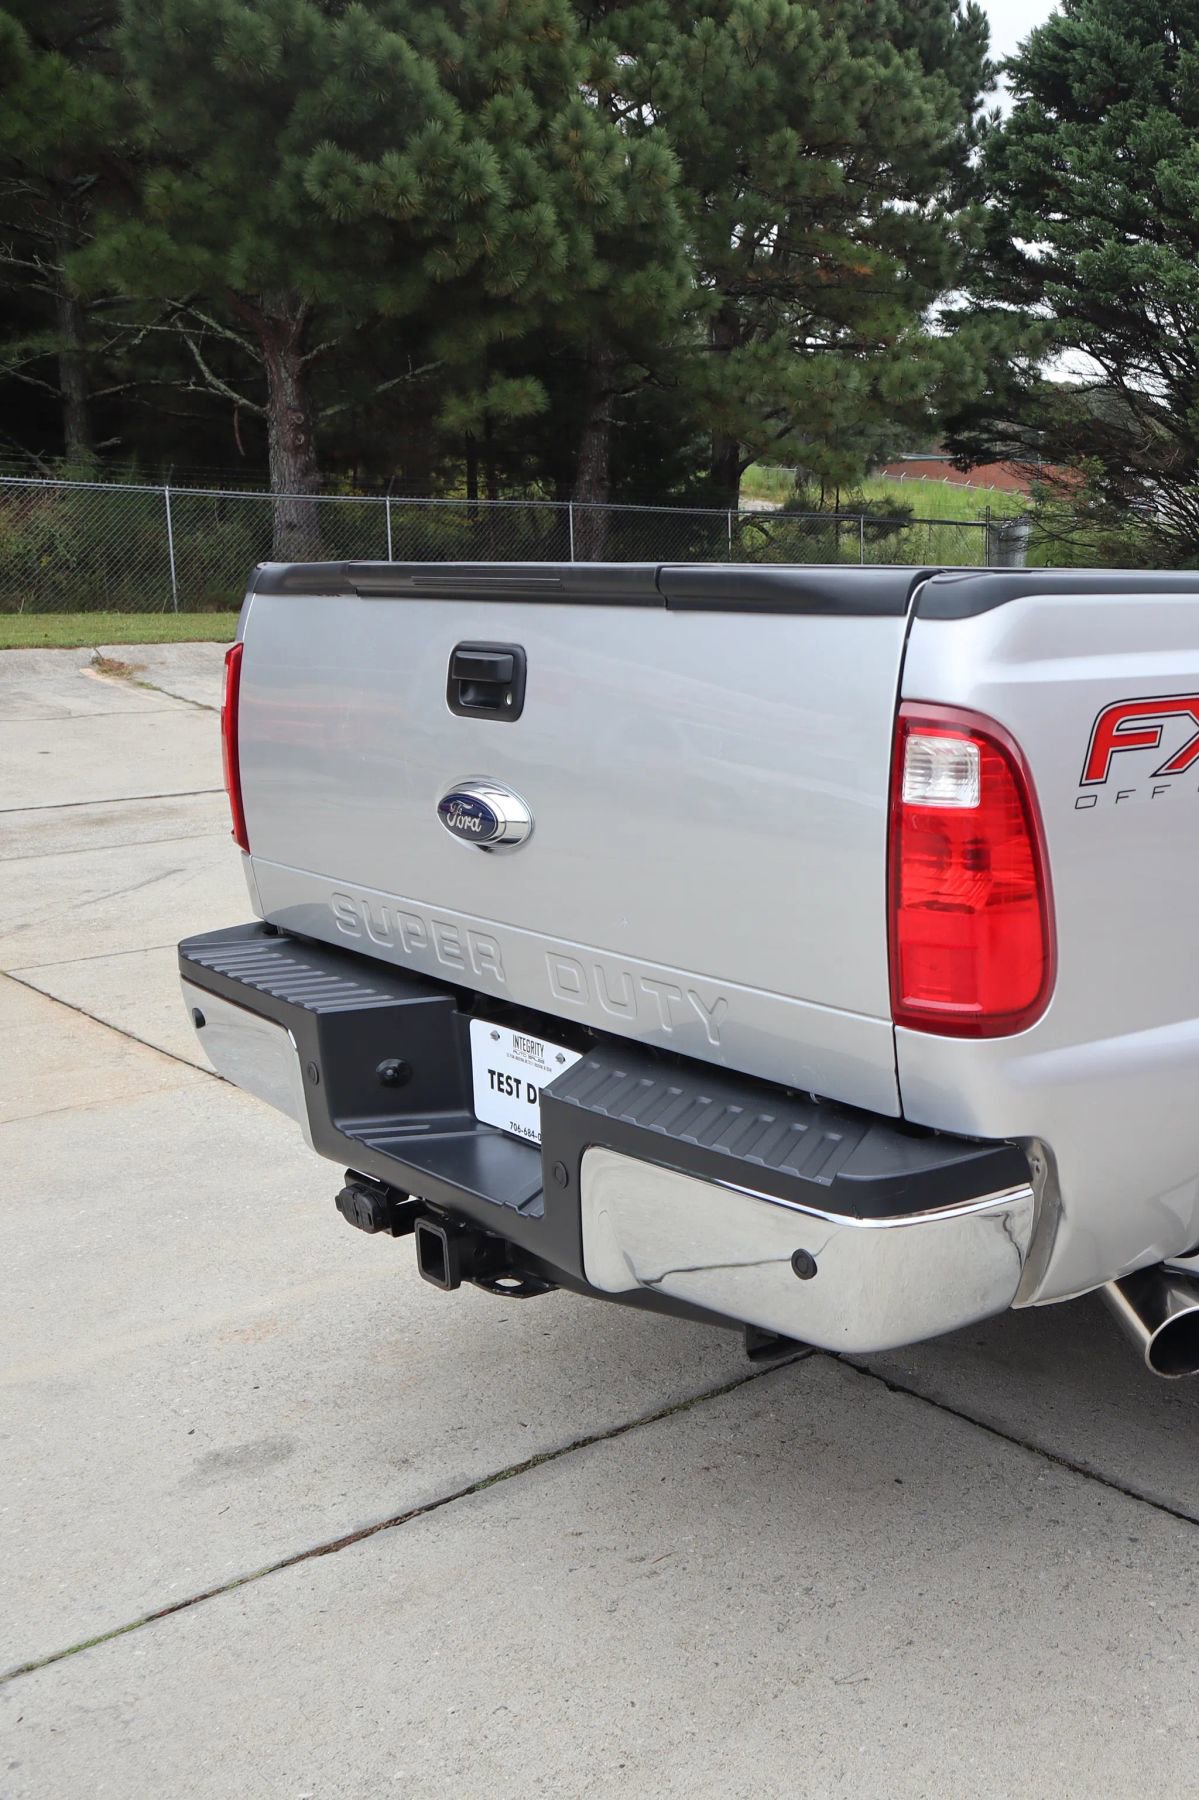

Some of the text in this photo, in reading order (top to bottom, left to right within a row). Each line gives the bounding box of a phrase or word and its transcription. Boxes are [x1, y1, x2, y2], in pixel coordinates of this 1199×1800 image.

[1074, 783, 1172, 809] OFF
[446, 799, 482, 832] Ford
[330, 892, 729, 1047] SUPER DUTY
[512, 1034, 545, 1058] INTEGRITY
[487, 1069, 522, 1099] TEST
